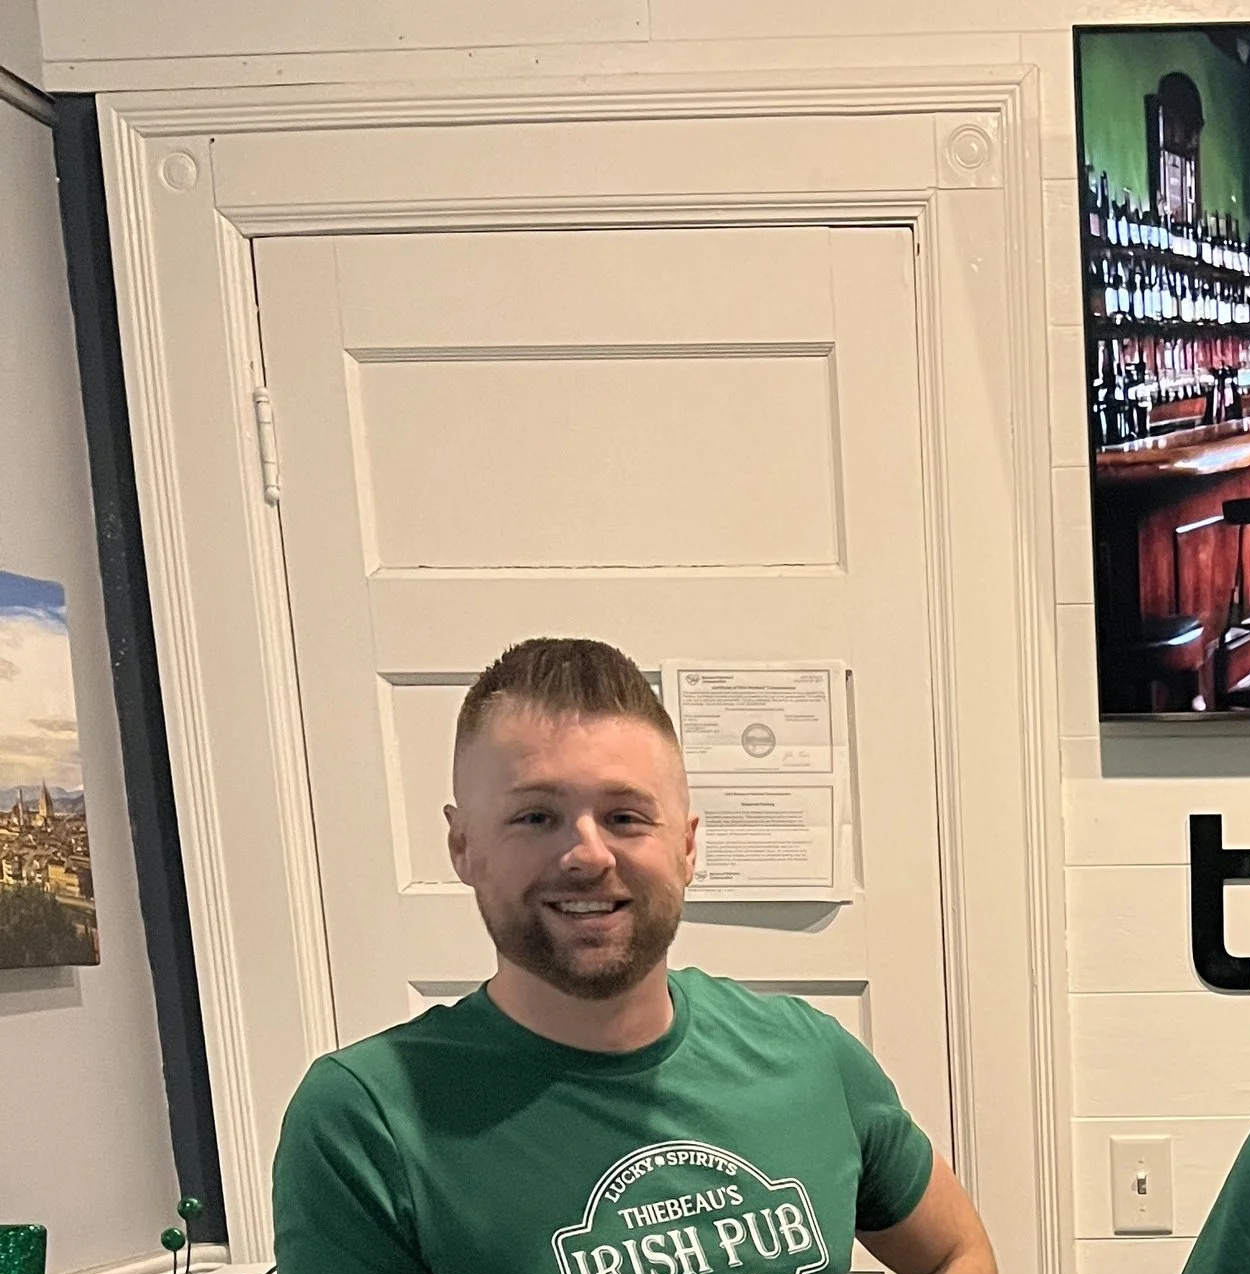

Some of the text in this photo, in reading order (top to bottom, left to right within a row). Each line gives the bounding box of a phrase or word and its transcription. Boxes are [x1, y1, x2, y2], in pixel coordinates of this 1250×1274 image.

[604, 1151, 738, 1203] LUCKY SPIRITS
[618, 1185, 744, 1229] THIEBEAU'S
[713, 1203, 813, 1268] PUB
